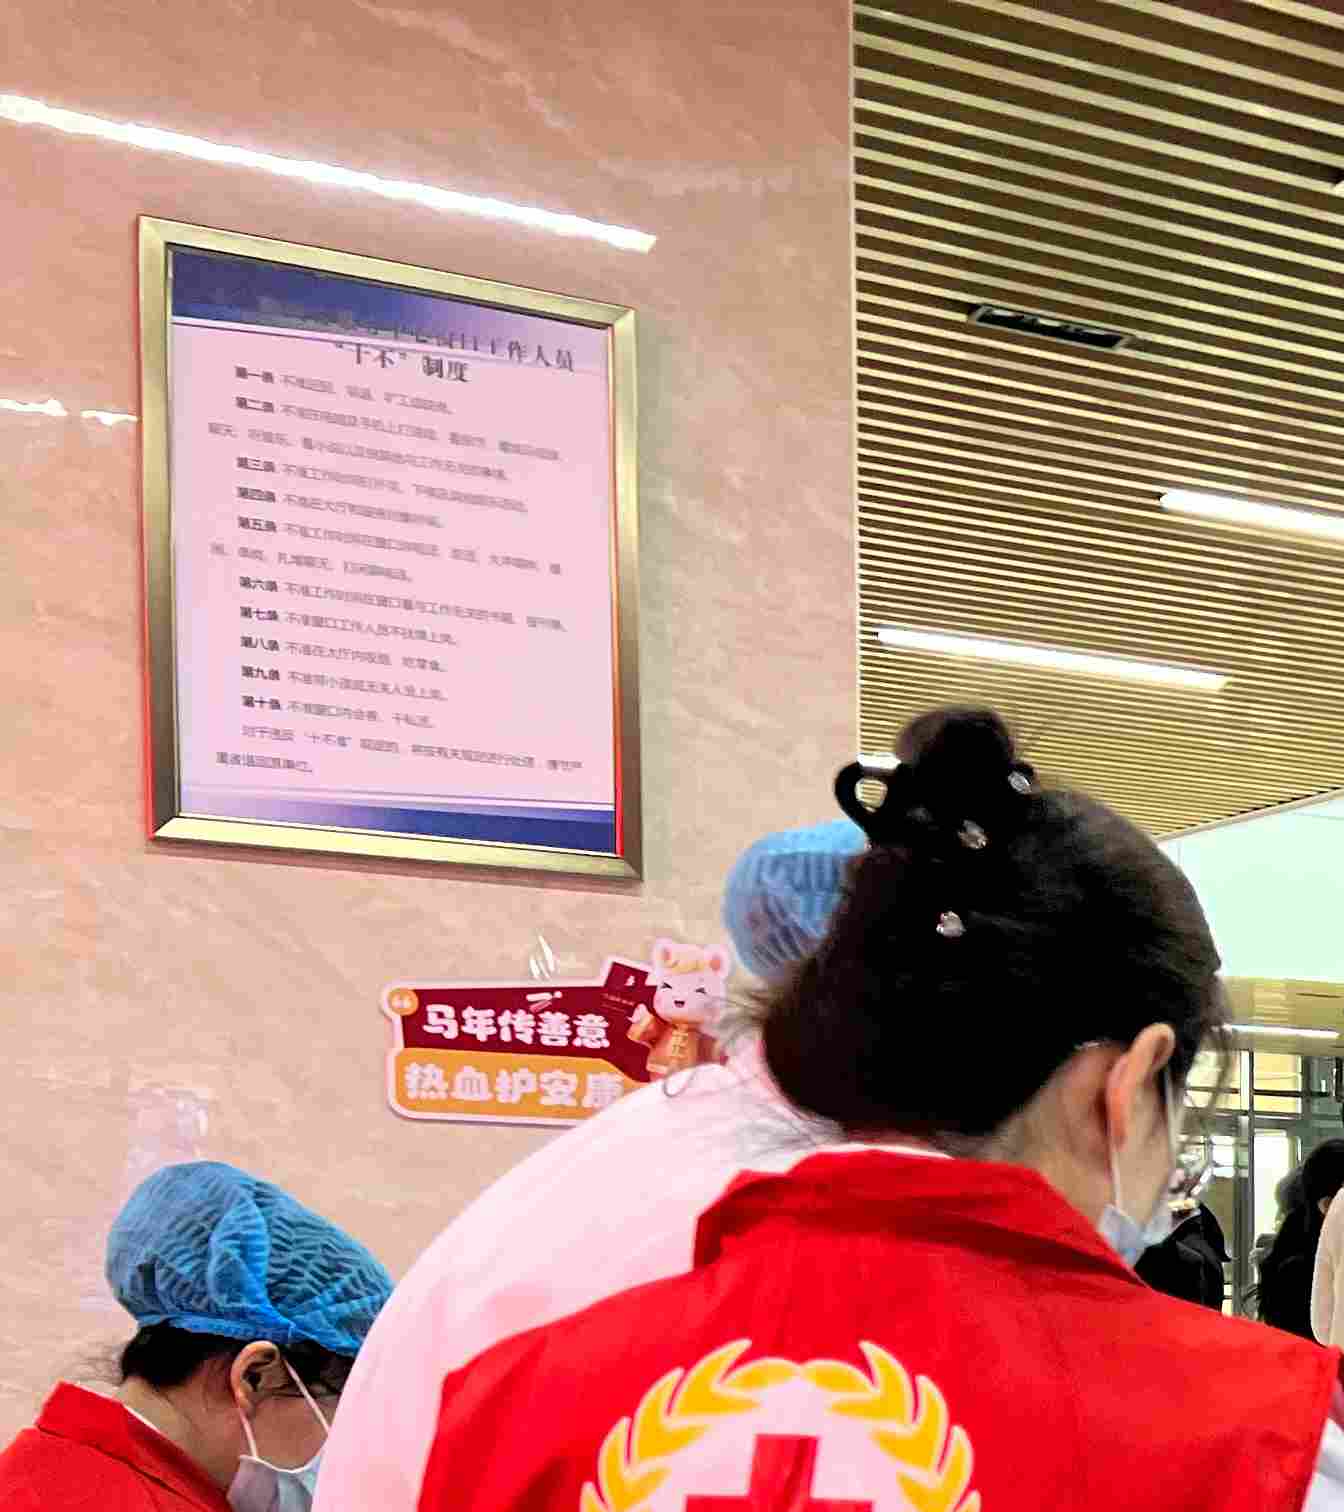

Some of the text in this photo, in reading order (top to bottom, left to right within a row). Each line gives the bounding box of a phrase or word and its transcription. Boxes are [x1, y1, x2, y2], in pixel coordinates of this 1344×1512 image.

[423, 1003, 610, 1049] 马年传善意
